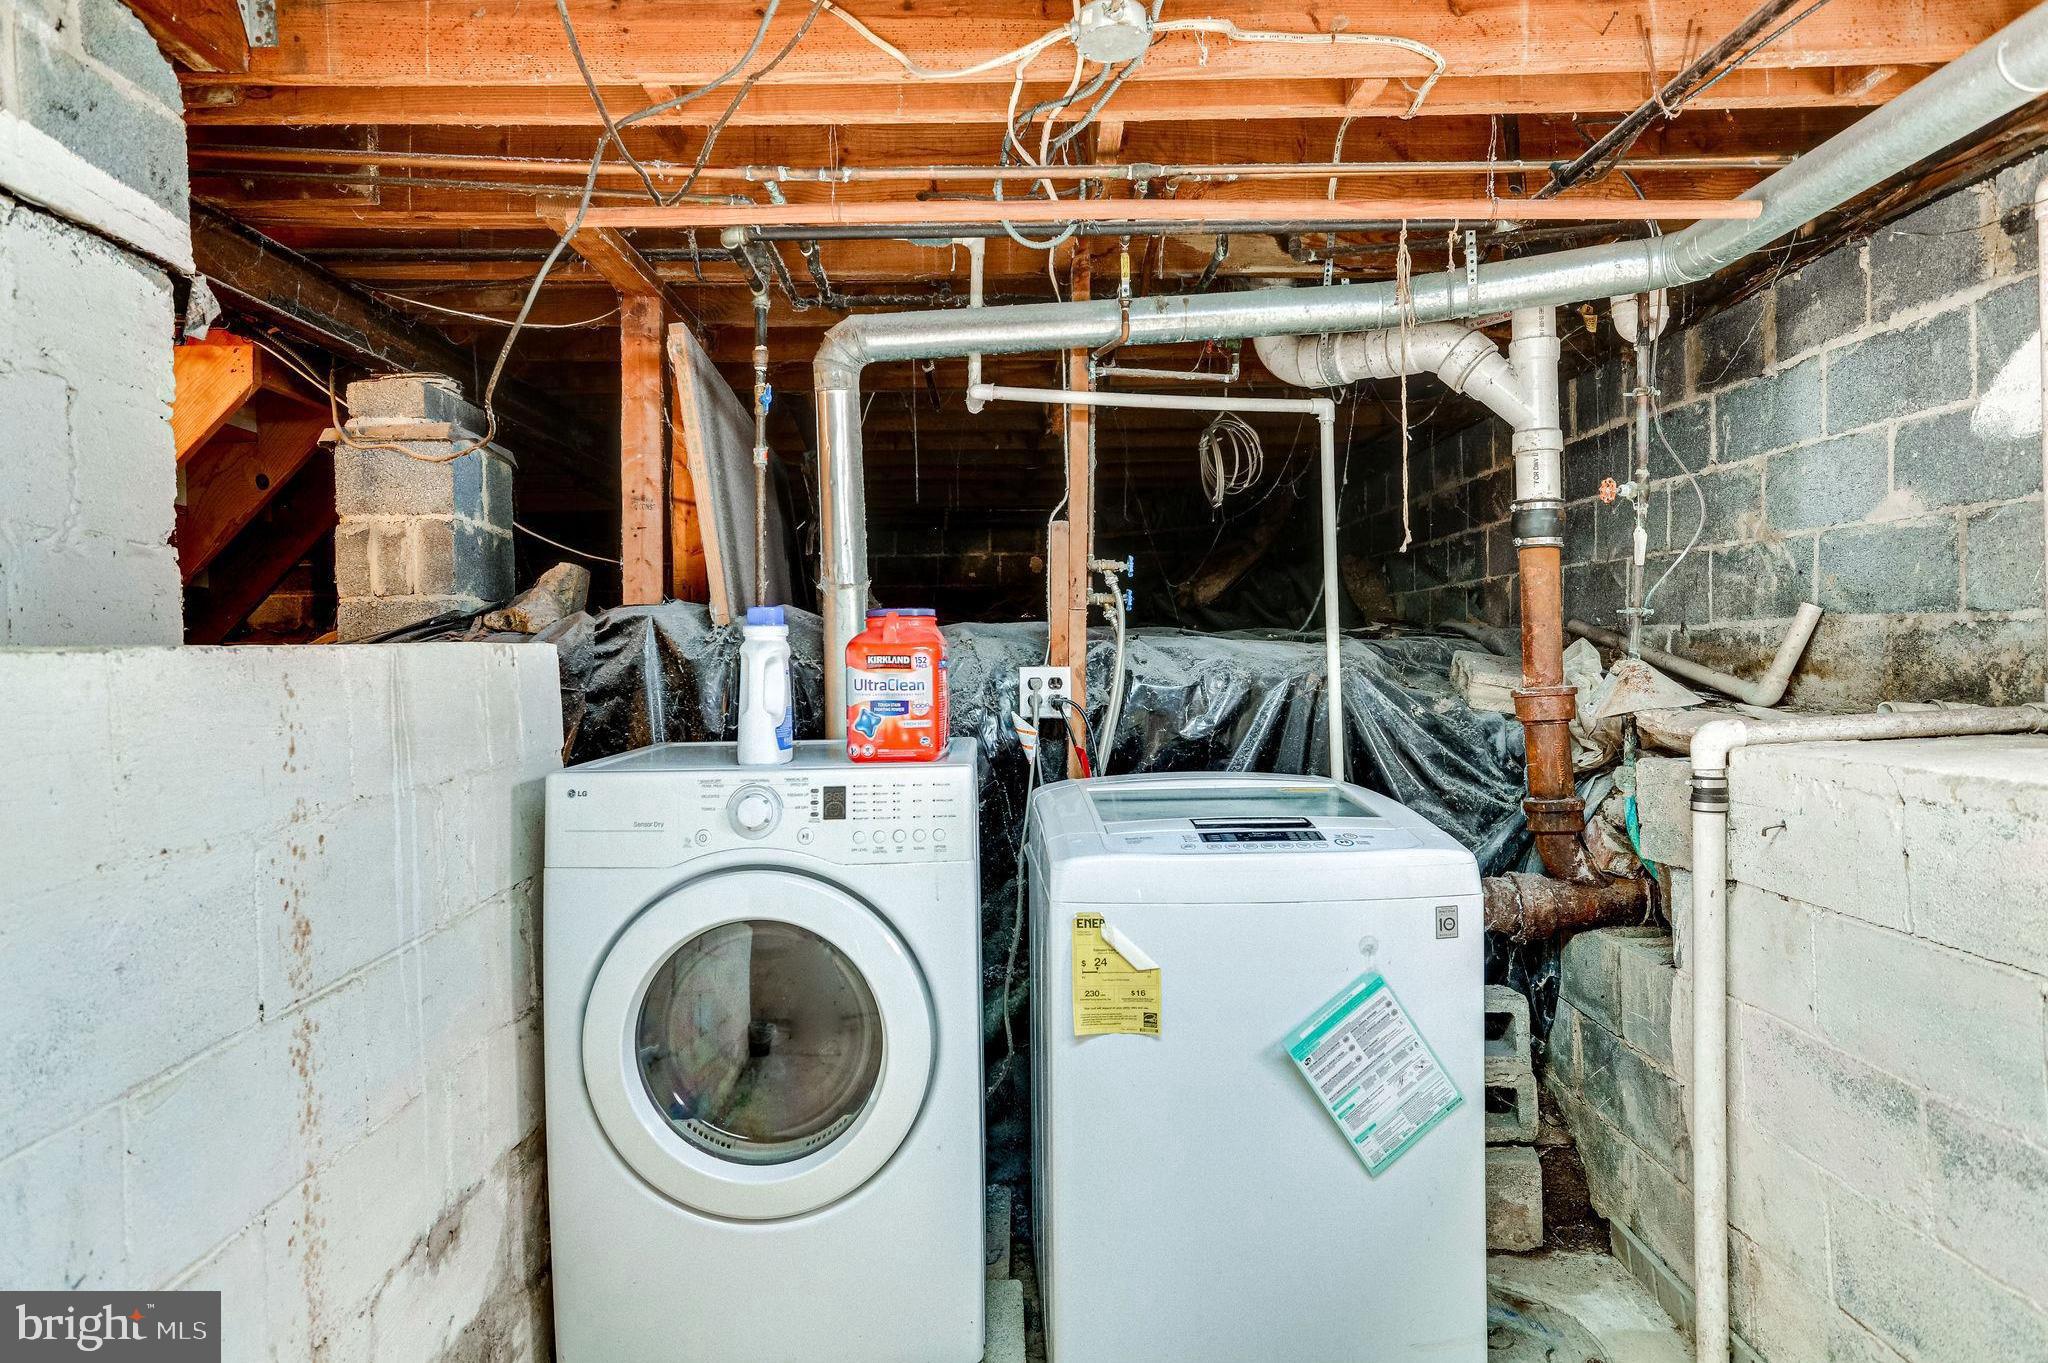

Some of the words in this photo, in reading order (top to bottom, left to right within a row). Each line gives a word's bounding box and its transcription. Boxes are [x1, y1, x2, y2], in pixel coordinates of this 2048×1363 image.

[867, 655, 911, 664] KIRKLAND
[914, 656, 927, 664] 152
[853, 678, 925, 691] UltraClean
[1094, 957, 1108, 967] 24
